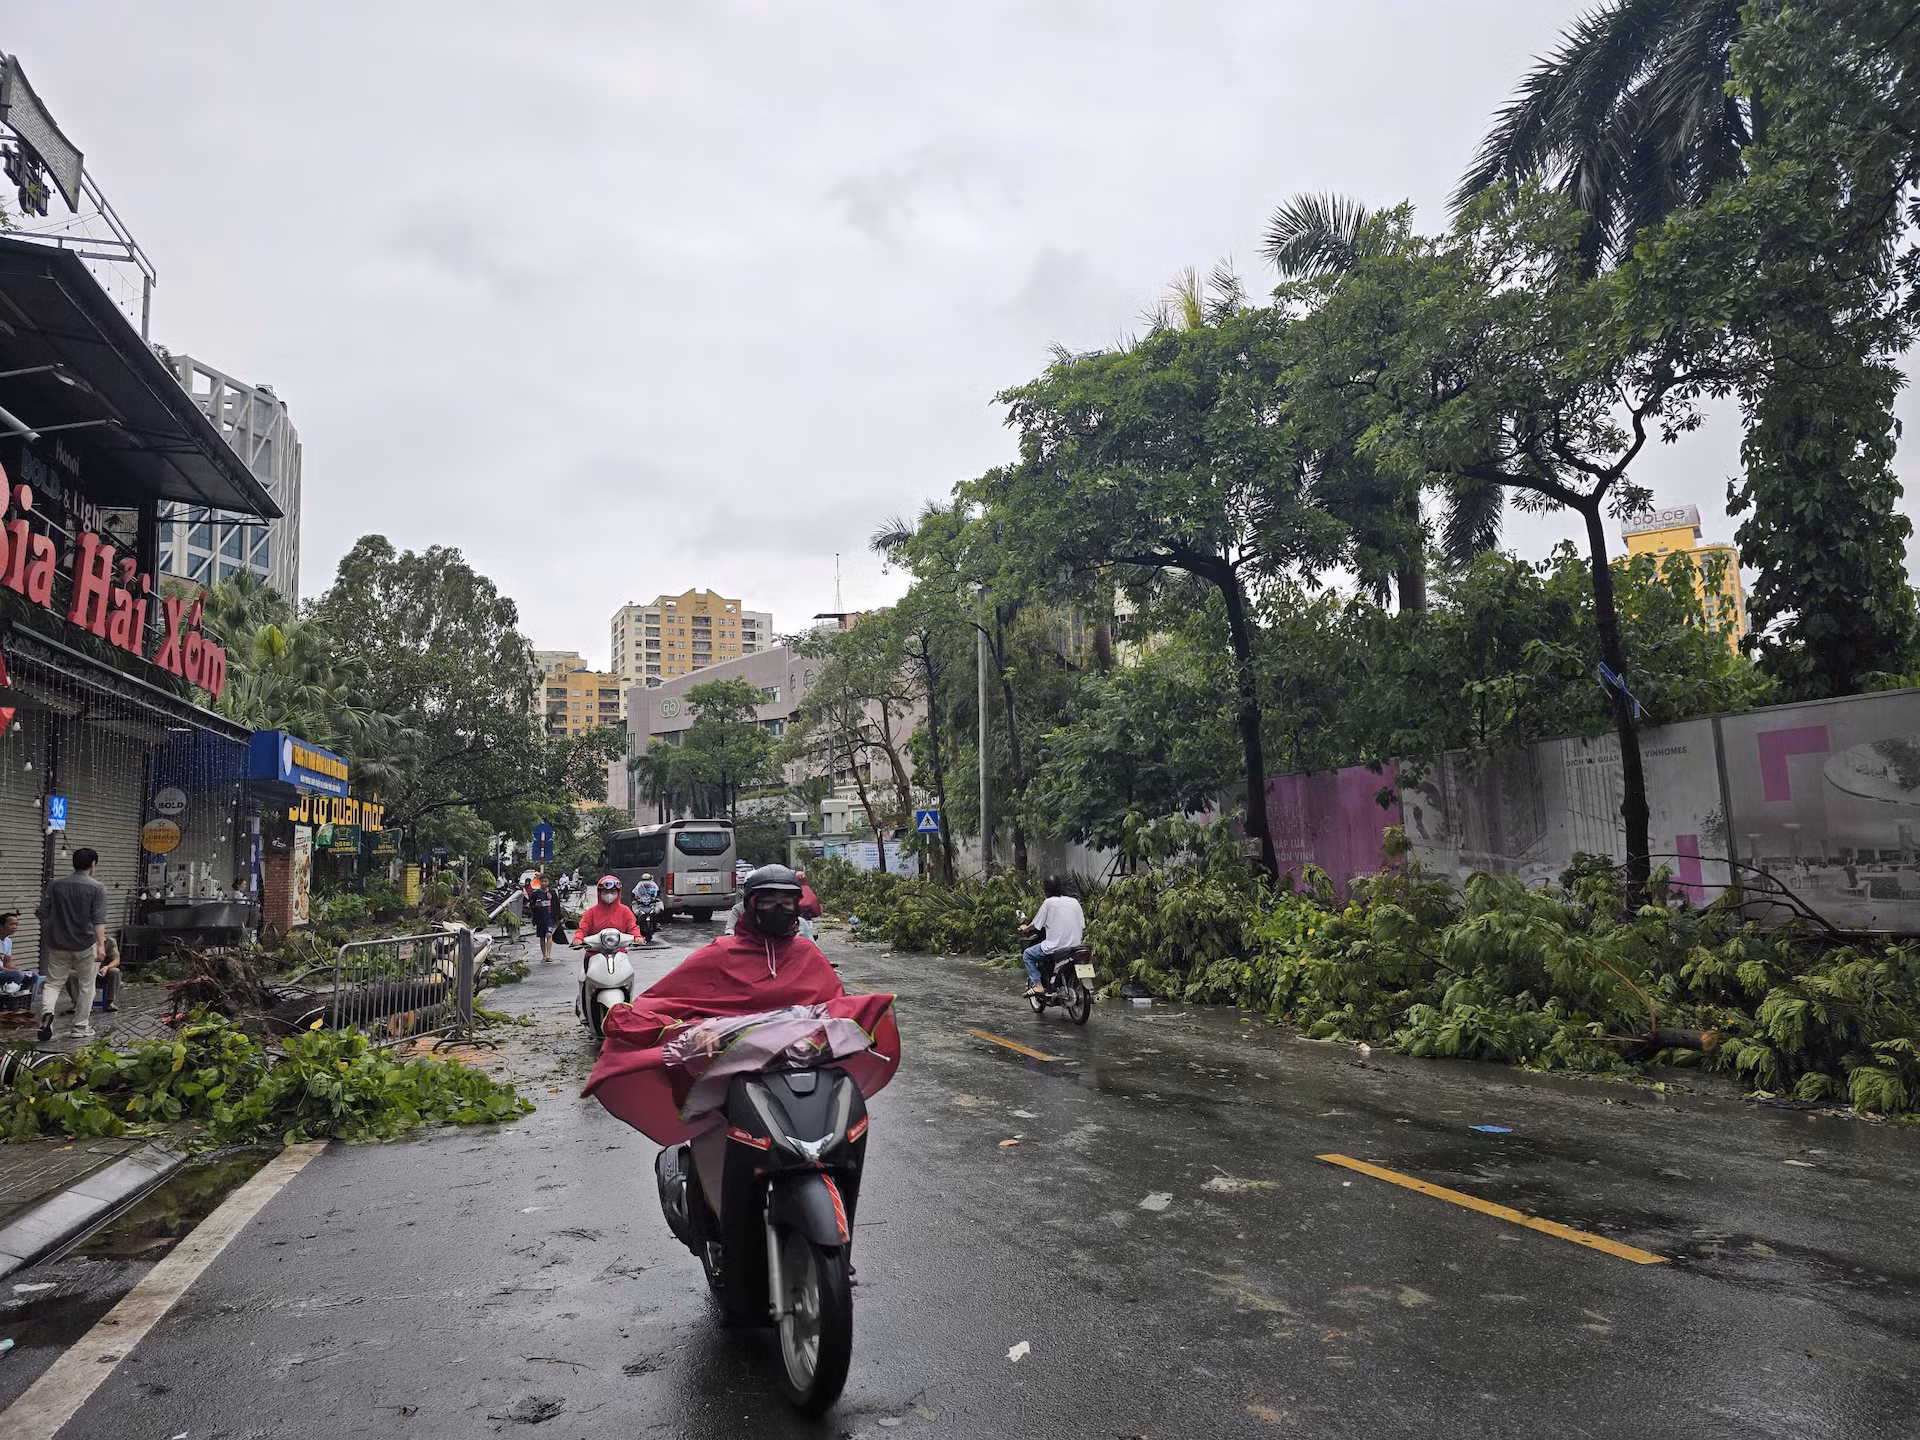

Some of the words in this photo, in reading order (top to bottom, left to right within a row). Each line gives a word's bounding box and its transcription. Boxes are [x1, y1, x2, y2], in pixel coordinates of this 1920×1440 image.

[55, 438, 80, 477] Hanoi
[63, 488, 71, 510] &
[0, 460, 56, 609] ia
[66, 532, 151, 657] Hải
[1644, 746, 1688, 758] VINHOMES
[52, 797, 64, 819] 86
[1294, 850, 1315, 861] VINH
